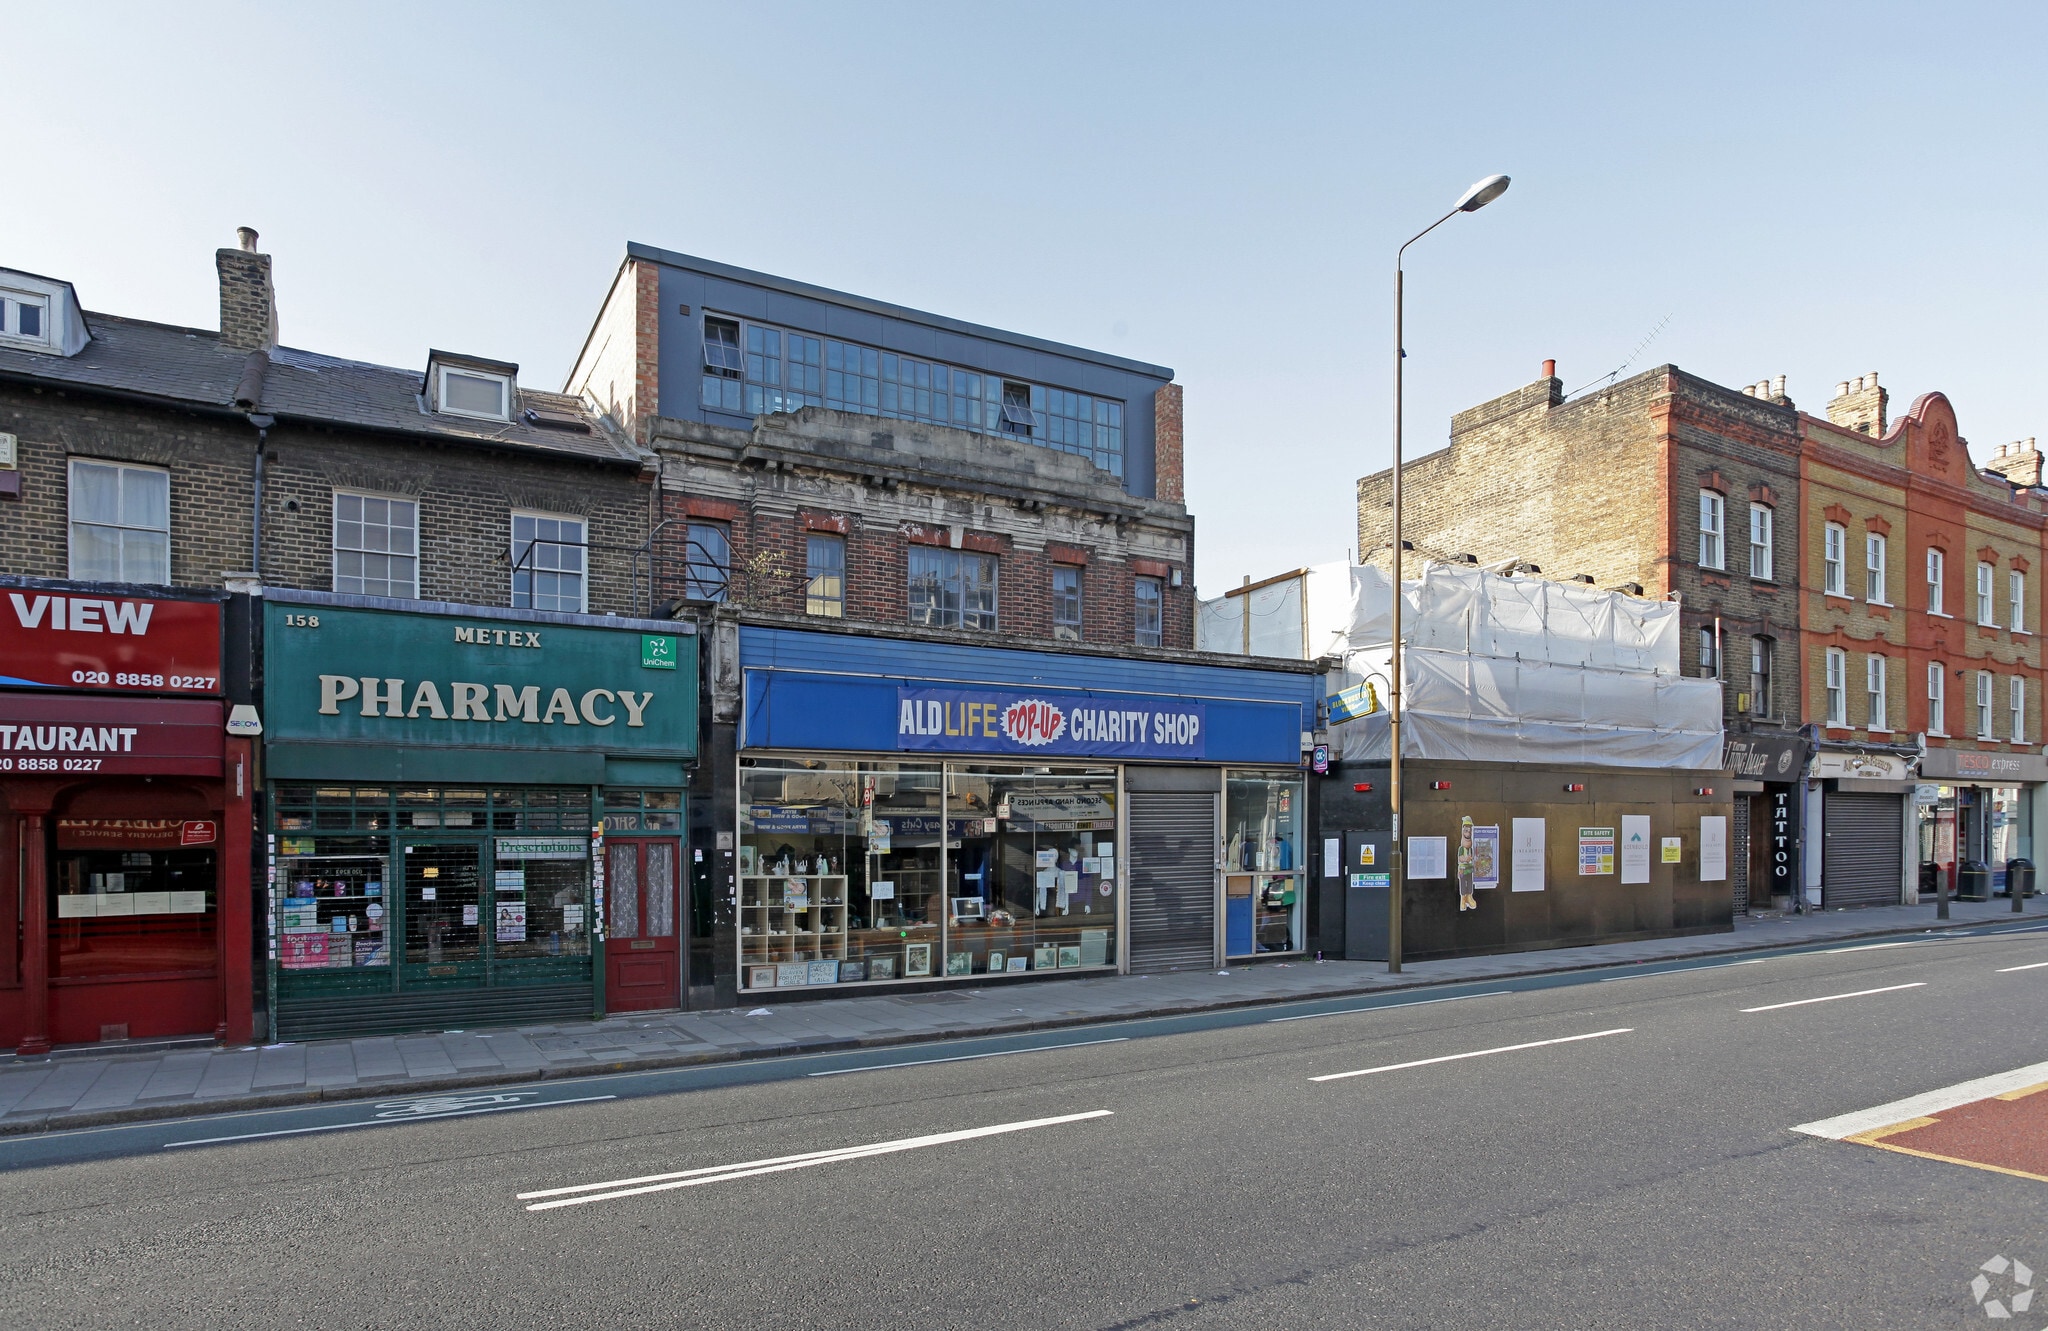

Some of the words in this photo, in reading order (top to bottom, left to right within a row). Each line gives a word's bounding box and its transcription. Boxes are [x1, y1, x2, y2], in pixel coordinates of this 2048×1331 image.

[9, 593, 154, 635] VIEW
[285, 614, 320, 627] 158
[453, 626, 542, 648] METEX
[643, 658, 675, 668] UniChem
[72, 670, 110, 685] 020
[115, 673, 164, 687] 8858
[169, 675, 216, 689] 0227
[318, 674, 654, 727] PHARMACY
[1007, 706, 1062, 741] POP-UP
[1070, 712, 1149, 744] CHARITY
[1153, 712, 1199, 745] SHOP
[18, 759, 58, 770] 8858
[63, 759, 102, 771] 0227
[1957, 754, 1990, 769] TESCO
[1992, 758, 2020, 773] express
[1774, 793, 1788, 877] TATTOO
[501, 841, 582, 854] Prescriptions
